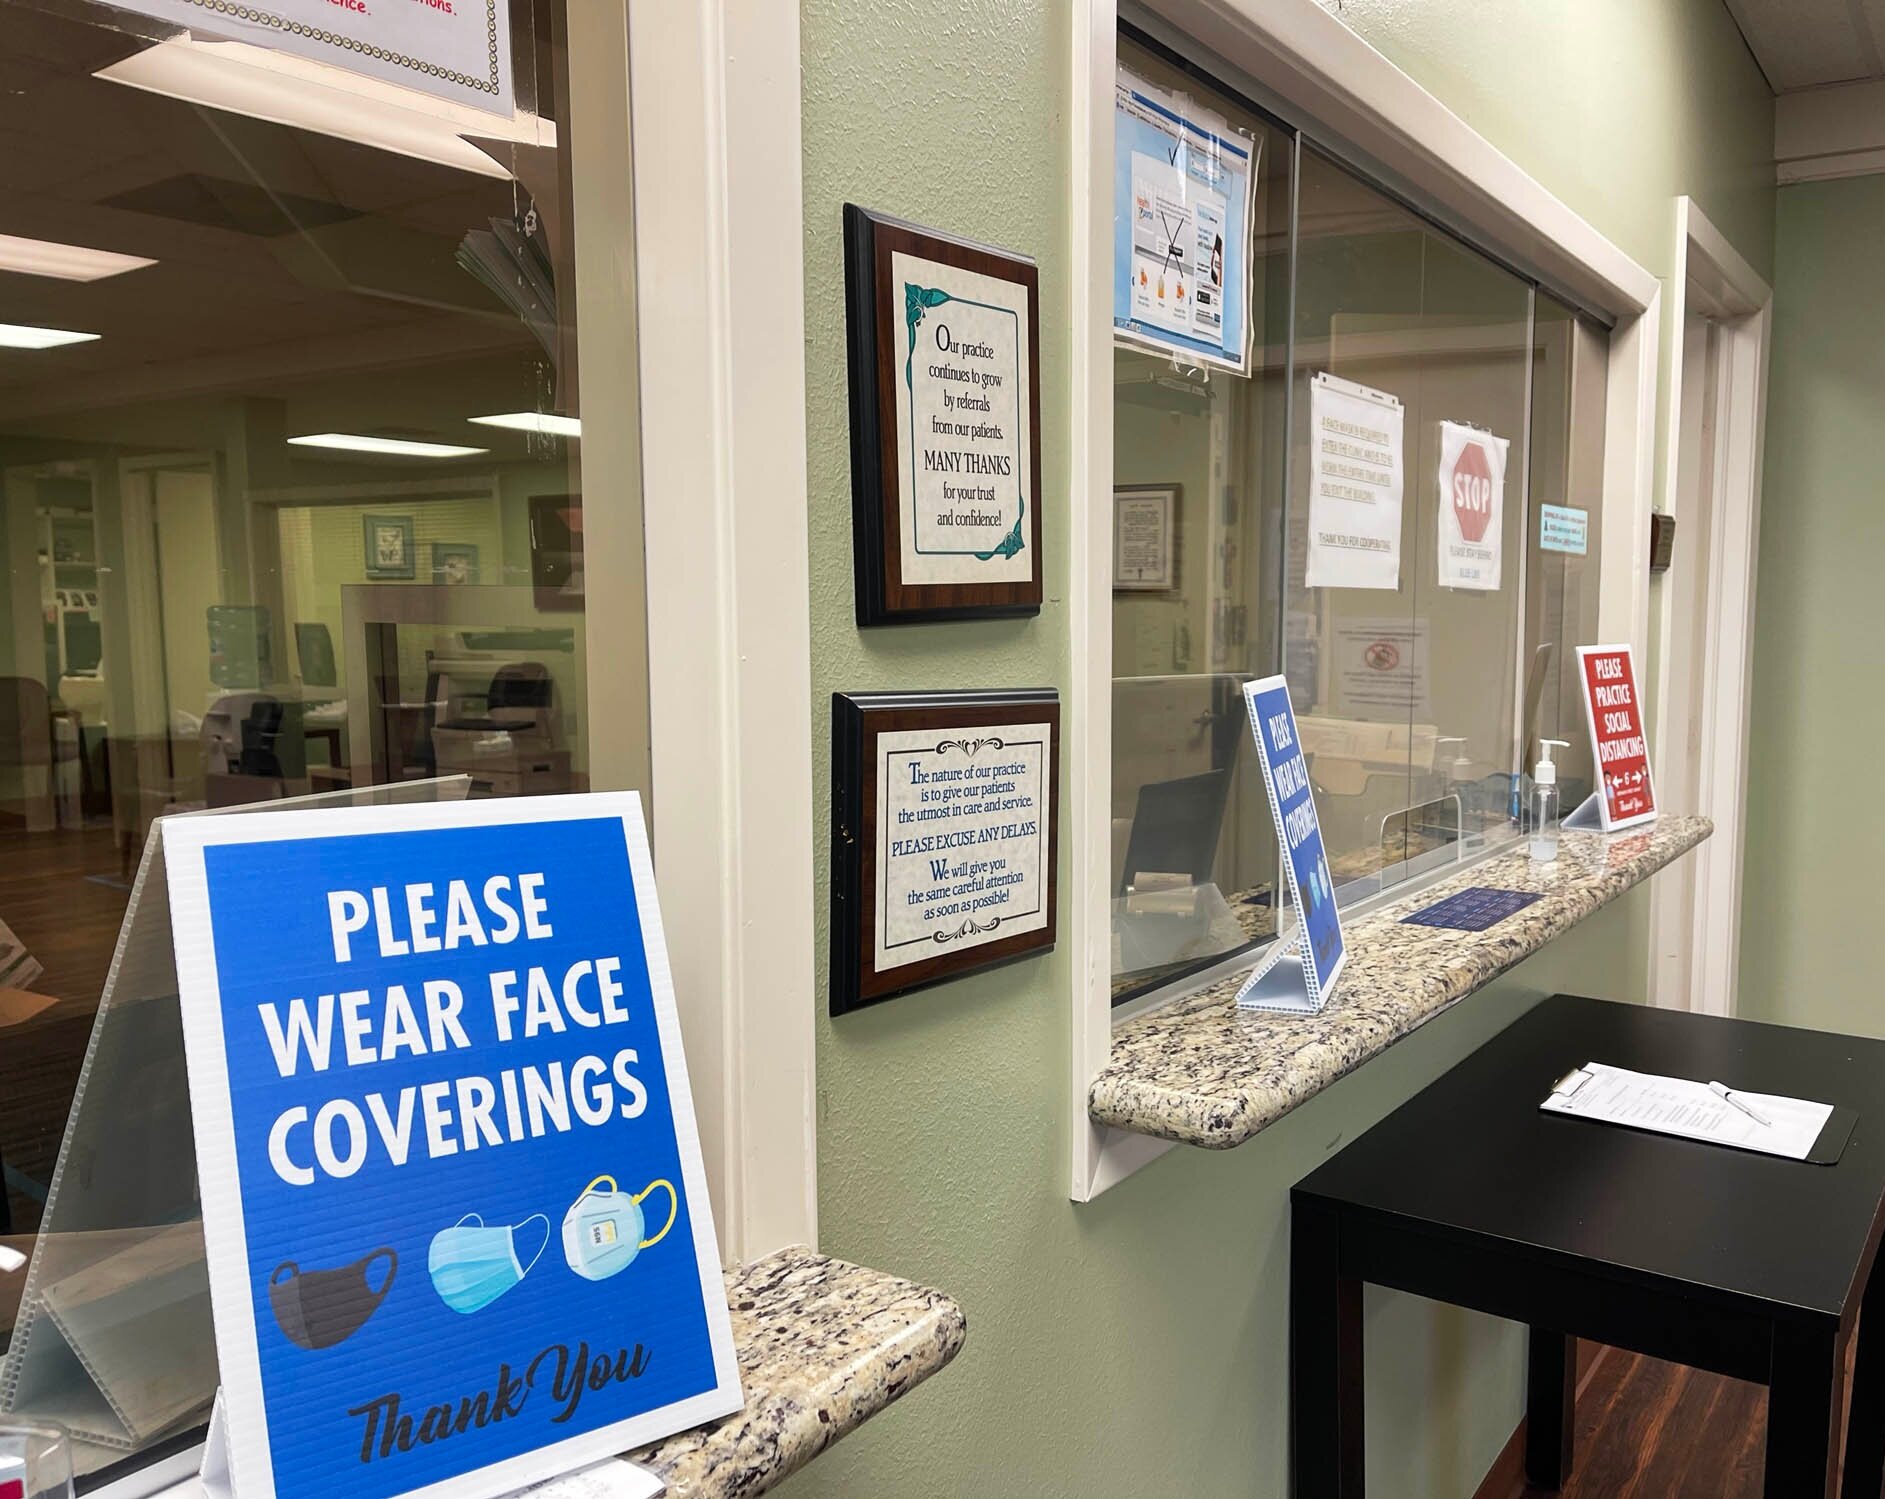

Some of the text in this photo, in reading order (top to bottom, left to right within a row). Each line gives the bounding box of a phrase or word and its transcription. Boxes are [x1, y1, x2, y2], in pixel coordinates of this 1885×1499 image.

[936, 324, 994, 359] Our practice
[929, 363, 1002, 390] continues to grow
[944, 390, 990, 412] by referrals
[933, 416, 1003, 441] from our patients.
[924, 450, 1010, 475] MANY THANKS
[944, 481, 995, 504] for your trust
[1454, 472, 1490, 513] STOP
[937, 509, 1002, 526] and confidence!
[1318, 532, 1336, 544] THANK
[1337, 534, 1348, 546] YOU
[1595, 658, 1623, 680] PLEASE
[1595, 684, 1631, 706] PRACTICE
[1269, 712, 1292, 752] PLEASE
[1604, 711, 1631, 734] SOCIAL
[1600, 736, 1644, 762] DISTANCING
[909, 762, 1026, 784] The nature of our practice
[1273, 754, 1306, 802] WEAR FACE
[921, 781, 1015, 803] is to give our patients
[898, 795, 1033, 823] the utmost in care and service.
[1286, 797, 1316, 850] COVERINGS
[892, 821, 1037, 857] PLEASE EXCUSE ANY DELAYS.
[930, 858, 1006, 881] We will give you
[908, 872, 1023, 905] the same careful attention
[924, 888, 1009, 920] as soon as possible!
[327, 872, 553, 963] PLEASE
[258, 956, 629, 1078] WEAR FACE
[267, 1048, 648, 1186] COVERINGS
[593, 1226, 602, 1243] N95
[348, 1341, 653, 1463] Thank You
